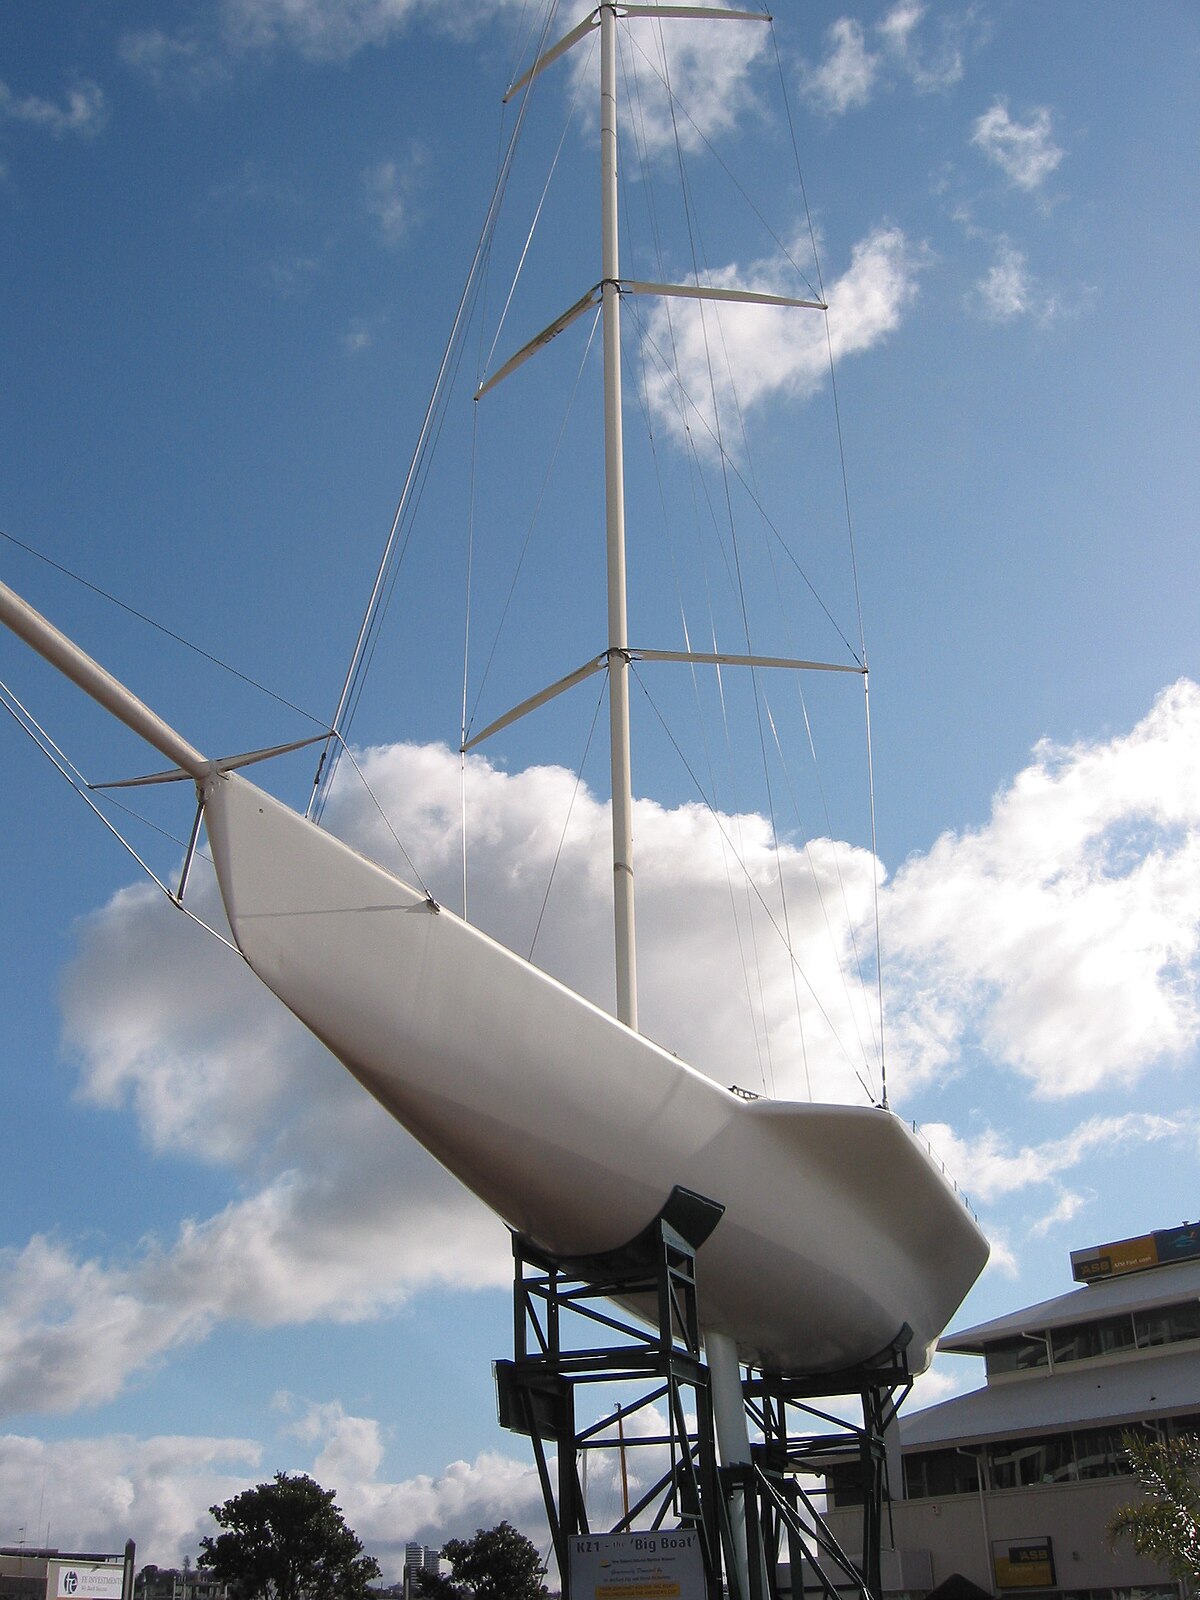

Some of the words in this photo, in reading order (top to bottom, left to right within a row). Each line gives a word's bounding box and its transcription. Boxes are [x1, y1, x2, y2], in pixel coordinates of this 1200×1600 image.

[1082, 1262, 1110, 1275] ASB
[577, 1541, 600, 1553] KZ1
[1021, 1549, 1048, 1561] ASB
